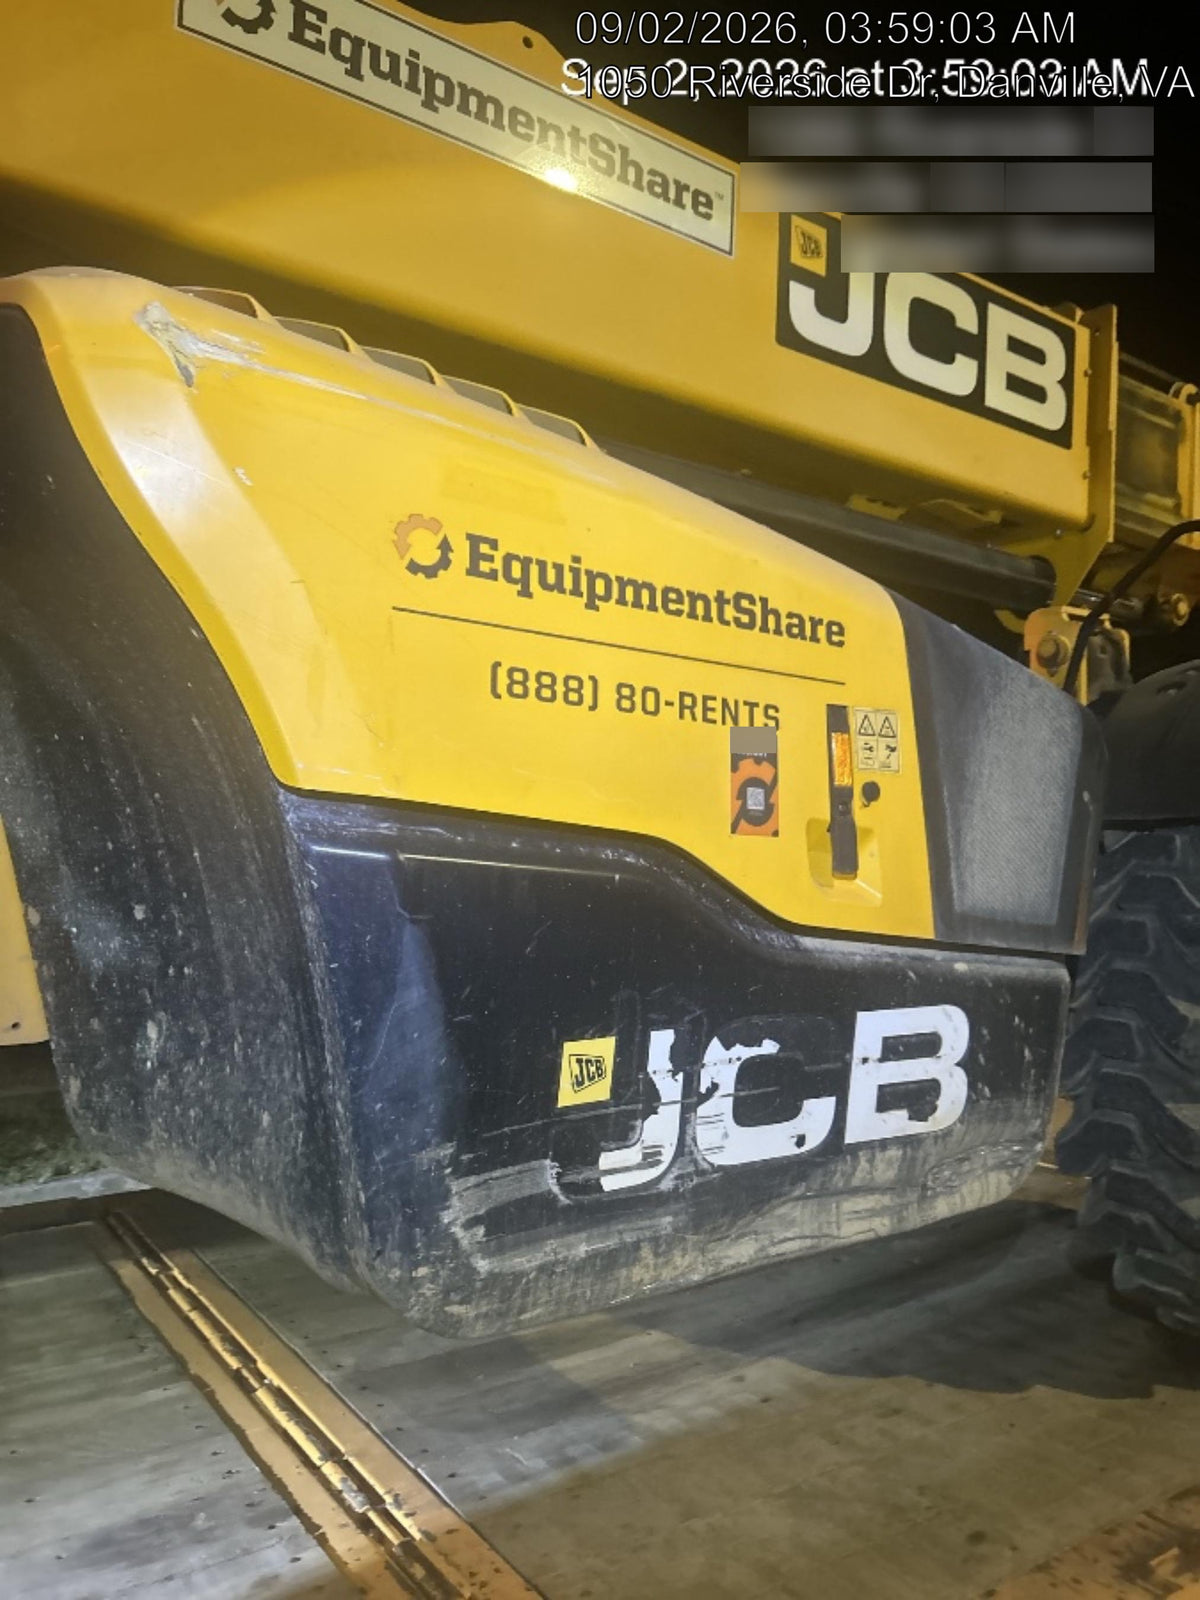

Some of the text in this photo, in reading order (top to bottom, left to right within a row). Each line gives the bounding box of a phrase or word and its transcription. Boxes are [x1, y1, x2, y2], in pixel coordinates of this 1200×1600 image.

[287, 0, 714, 221] EquipmentShare
[788, 272, 1067, 431] JCB
[465, 532, 846, 648] EquipmentShare
[490, 661, 780, 732] (888) 80-RENTS
[573, 1057, 604, 1088] JCB
[598, 1004, 970, 1192] JCB
